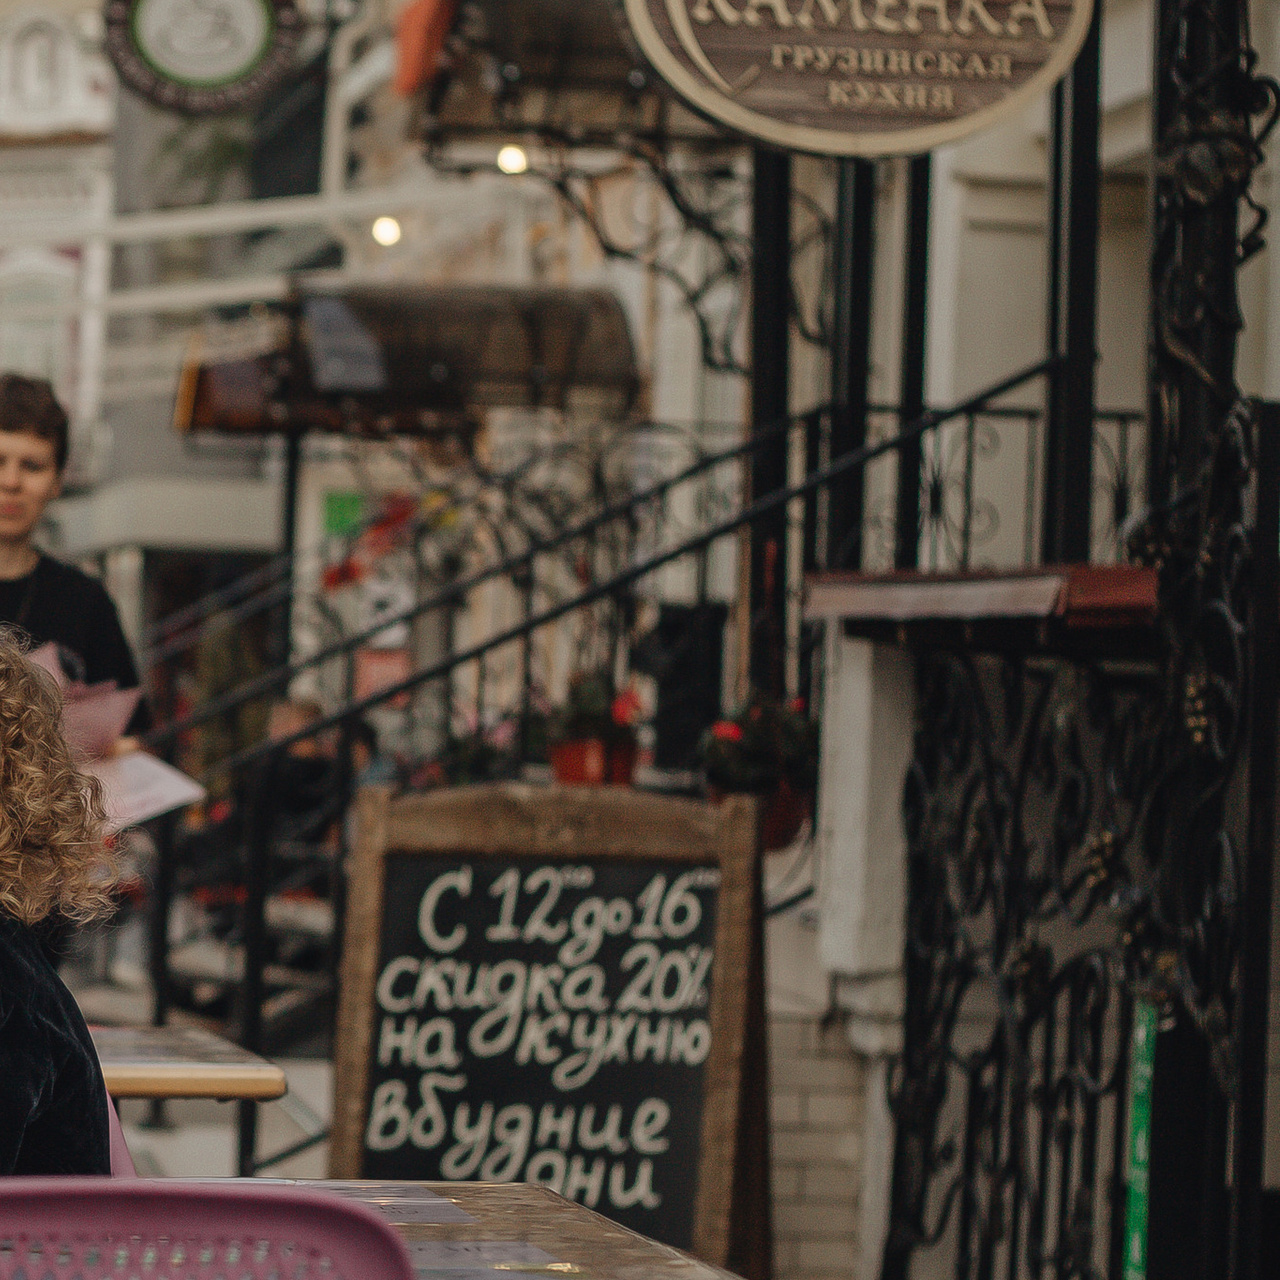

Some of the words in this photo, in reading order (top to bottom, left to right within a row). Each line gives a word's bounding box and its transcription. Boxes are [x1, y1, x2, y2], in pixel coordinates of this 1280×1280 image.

[770, 43, 1013, 79] ГРУЗИНСКАЯ
[826, 80, 956, 111] КУХНЯ
[378, 1015, 461, 1068] на
[516, 1012, 713, 1092] кухню
